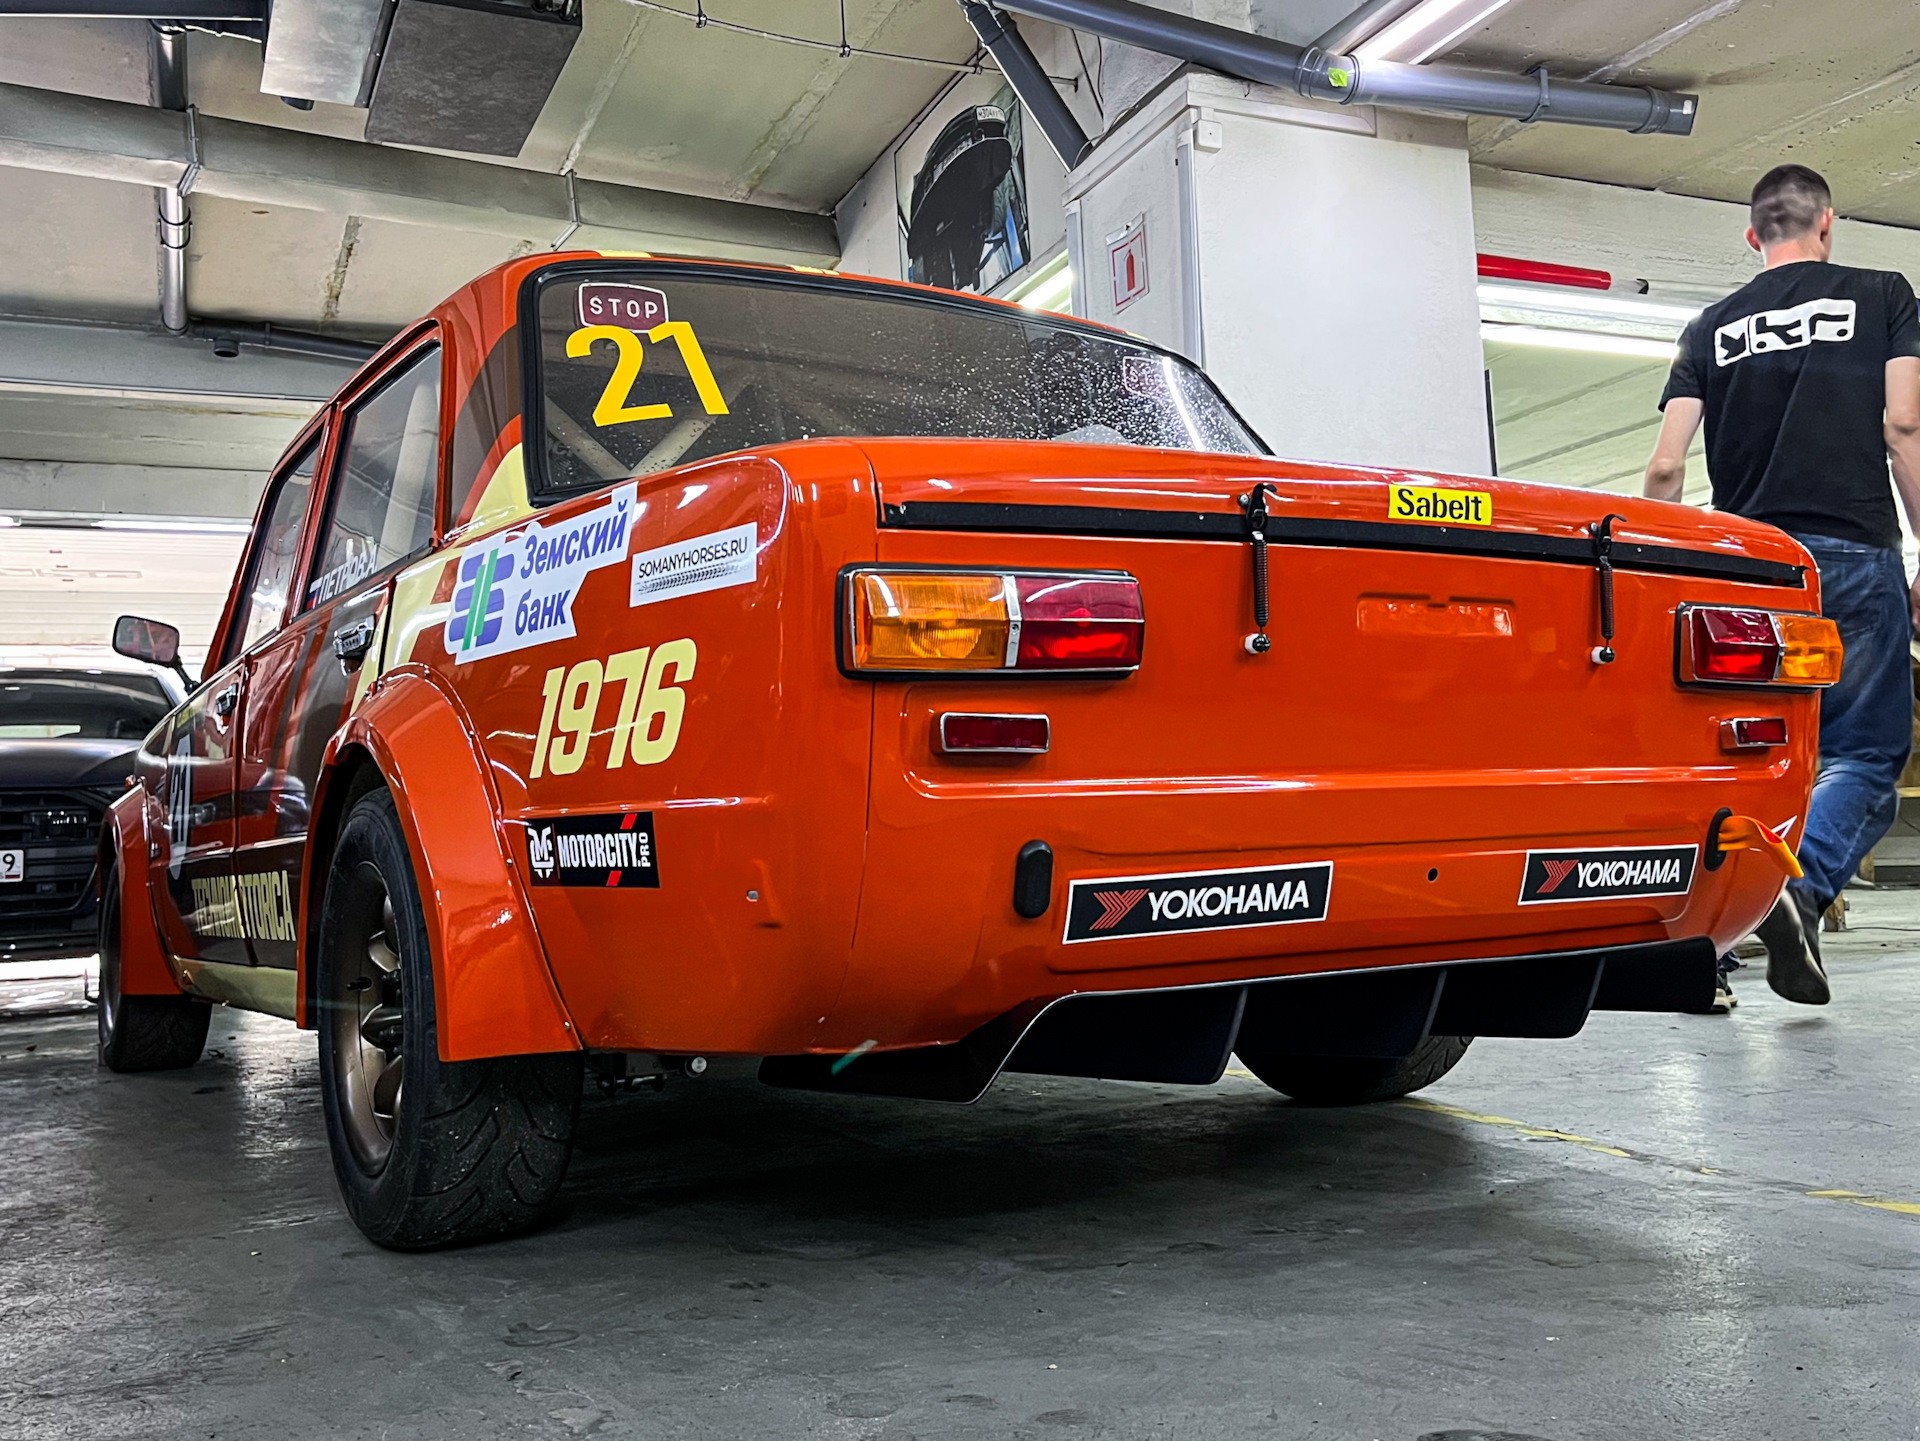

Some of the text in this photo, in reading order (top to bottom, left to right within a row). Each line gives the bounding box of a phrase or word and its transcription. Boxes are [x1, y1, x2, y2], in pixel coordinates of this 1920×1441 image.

[589, 297, 658, 319] STOP
[566, 321, 730, 427] 21
[1397, 488, 1482, 522] Sabelt
[520, 499, 628, 580] Земский
[638, 536, 748, 579] SOMANYHORSES.RU
[515, 588, 571, 637] банк
[529, 637, 697, 779] 1976
[557, 832, 637, 868] MOTORCITY
[1577, 859, 1681, 888] YOKOHAMA
[1148, 880, 1309, 921] YOKOHAMA
